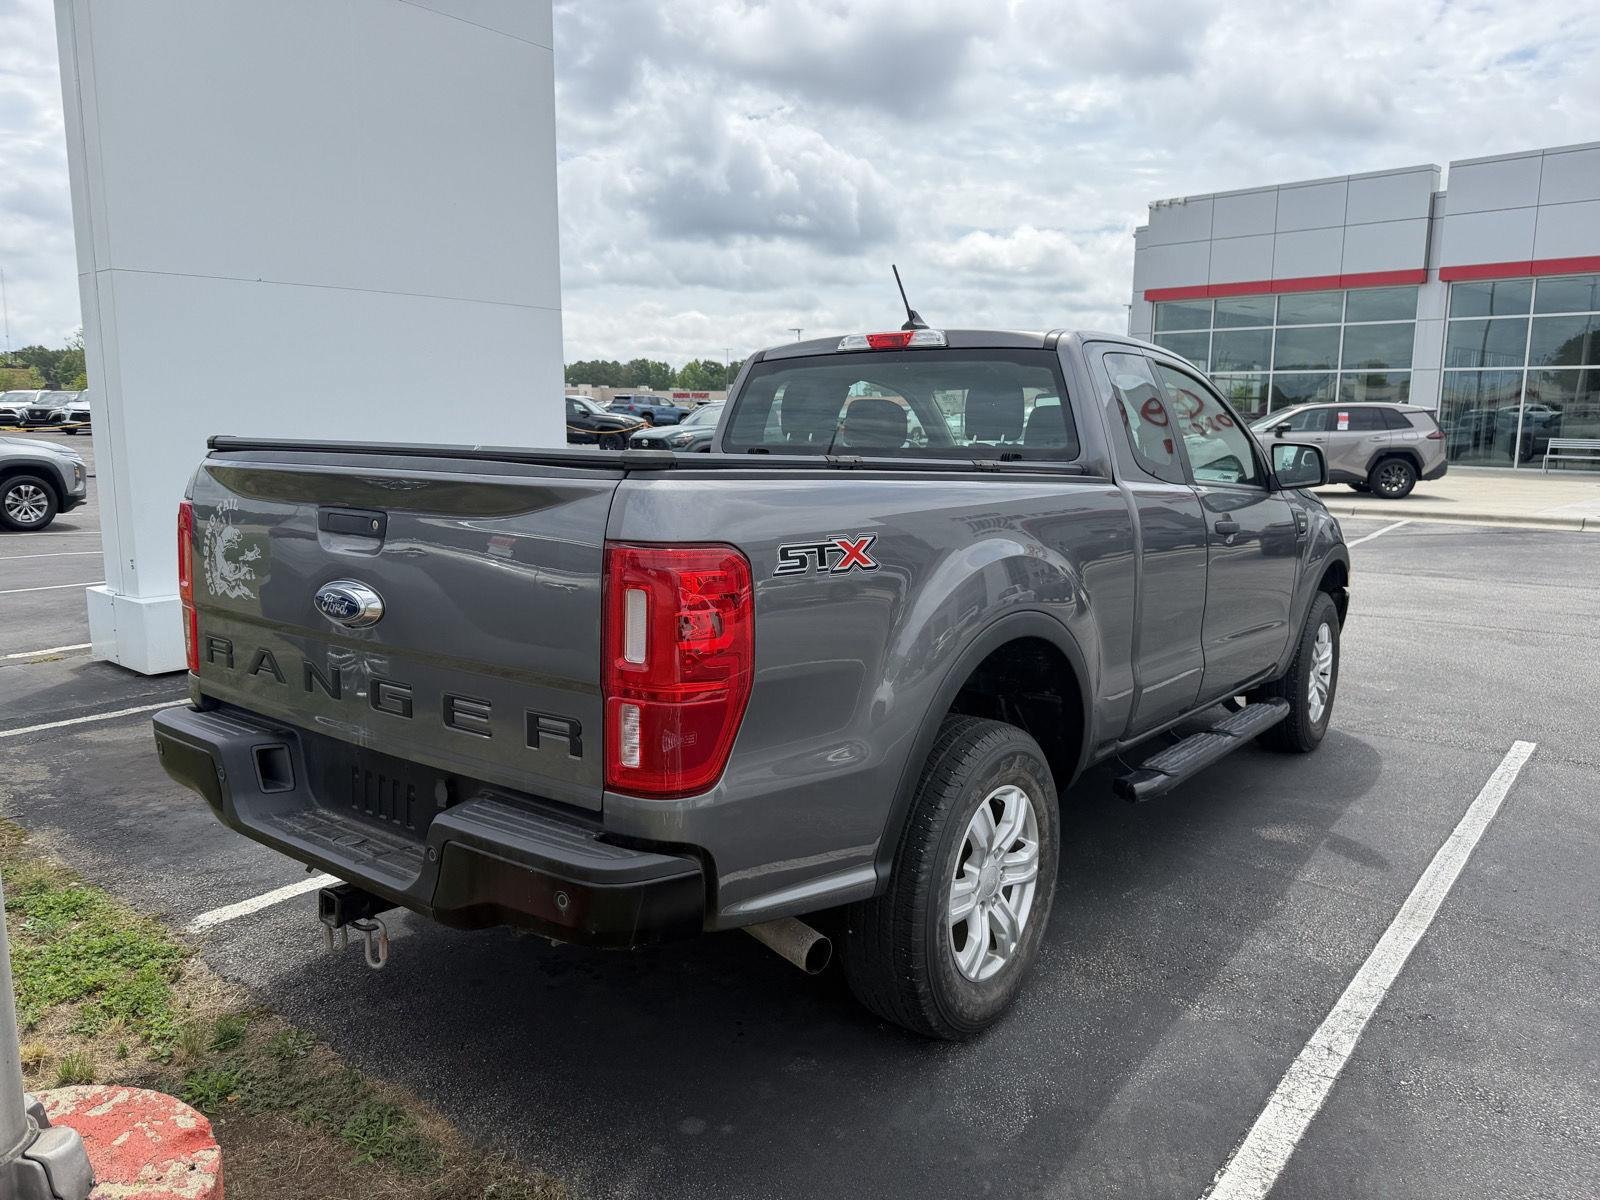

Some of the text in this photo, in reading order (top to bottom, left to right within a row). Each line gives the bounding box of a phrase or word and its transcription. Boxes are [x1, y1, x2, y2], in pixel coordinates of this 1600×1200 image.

[216, 498, 239, 515] TAIL
[773, 532, 881, 577] STX
[321, 592, 348, 615] Ford
[206, 635, 583, 759] RANGER
